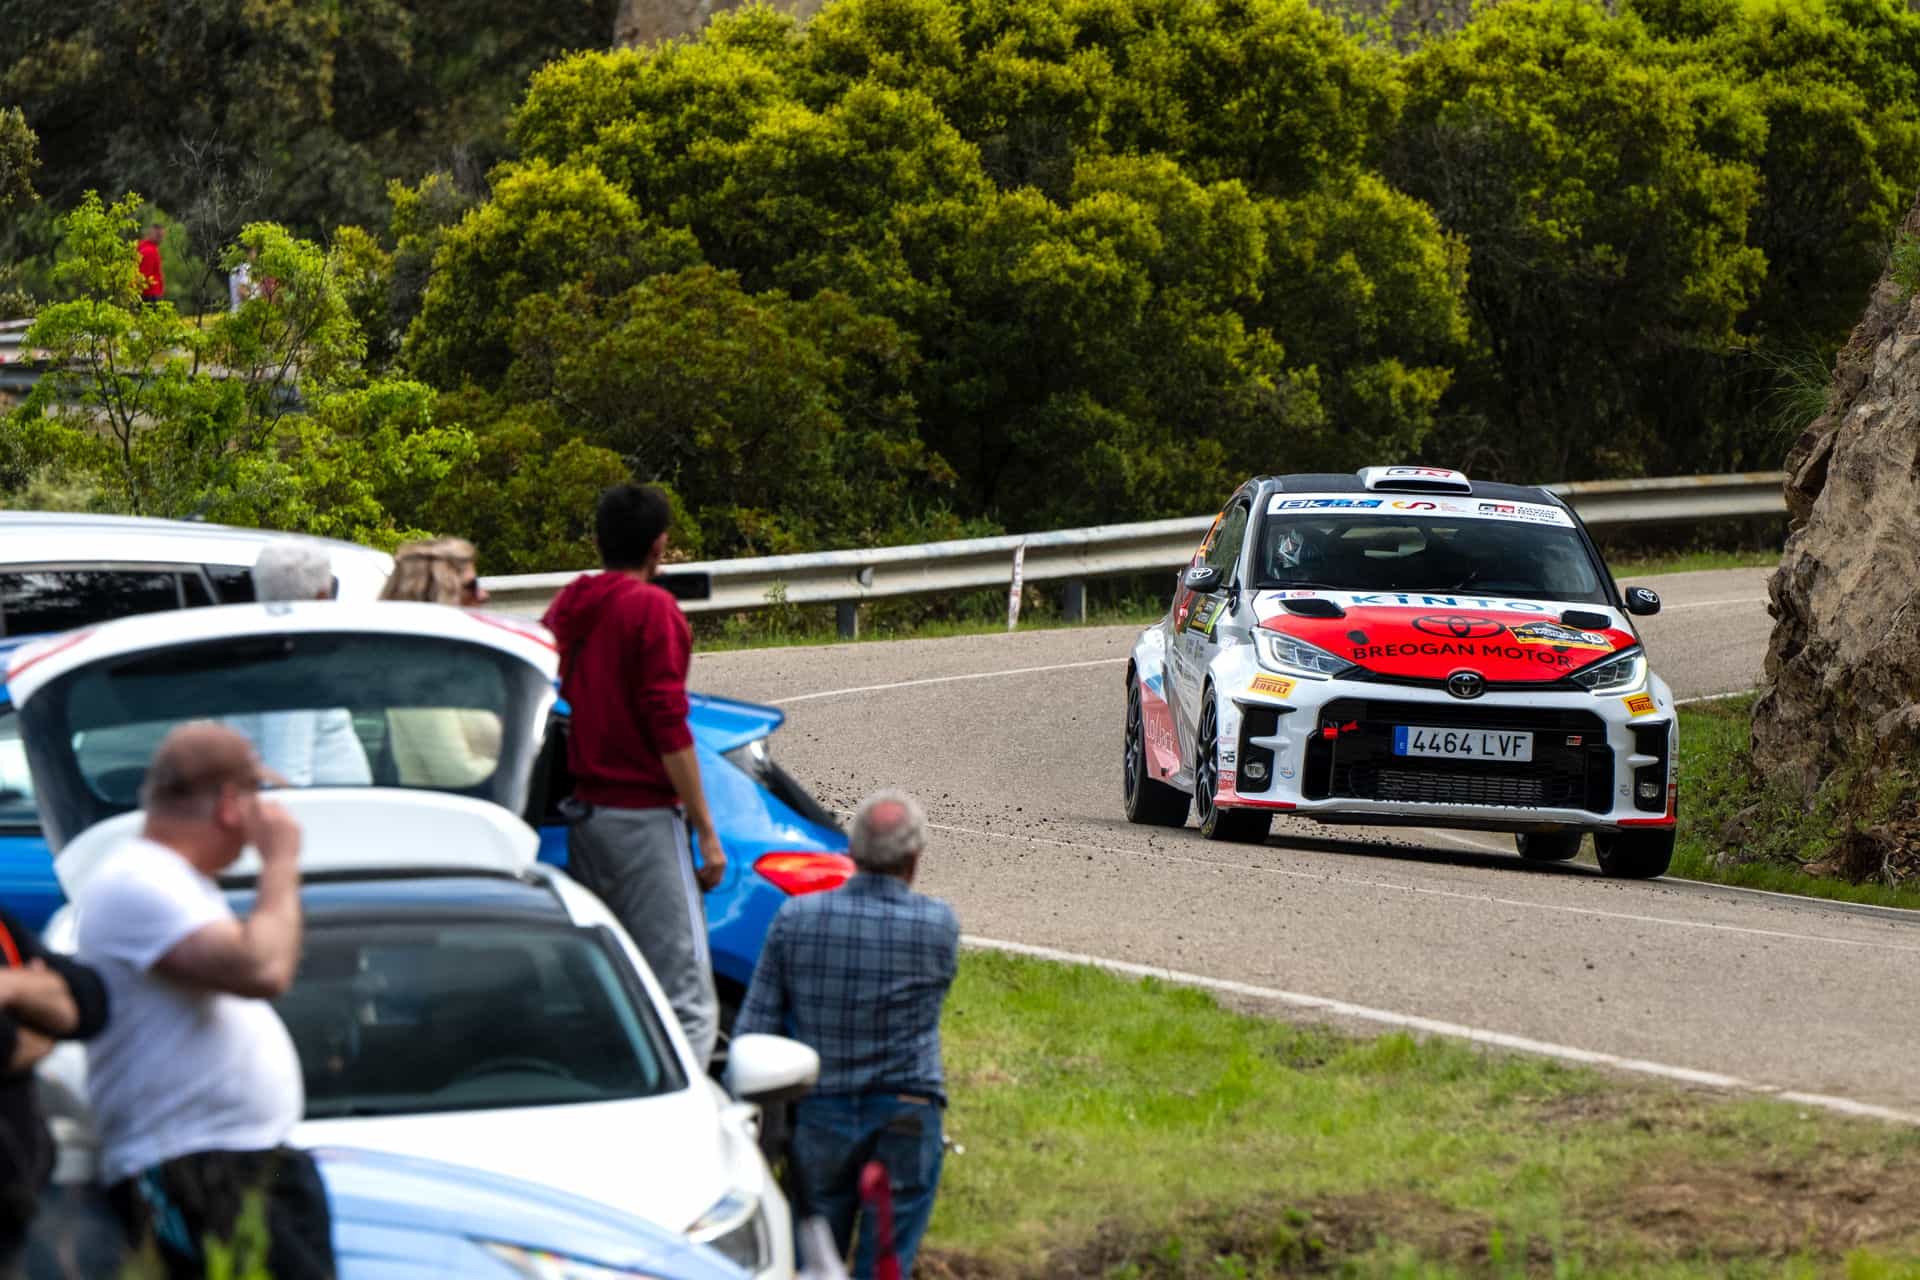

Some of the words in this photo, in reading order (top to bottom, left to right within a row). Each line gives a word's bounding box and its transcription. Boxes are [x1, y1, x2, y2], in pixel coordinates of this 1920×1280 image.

[1352, 594, 1544, 612] KINTO
[1353, 643, 1475, 660] BREOGAN
[1483, 646, 1573, 668] MOTOR
[1252, 677, 1291, 694] PIRELLI
[1413, 730, 1472, 754] 4464
[1482, 735, 1527, 757] LVF
